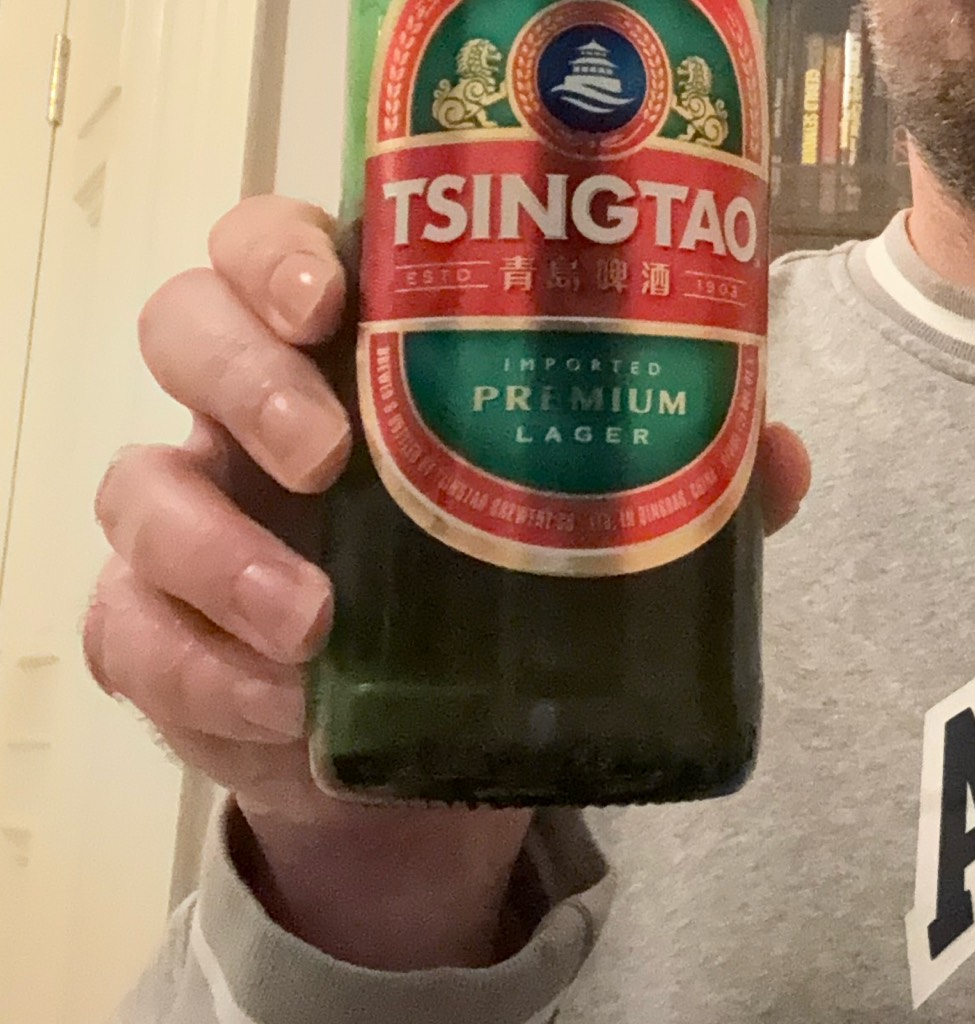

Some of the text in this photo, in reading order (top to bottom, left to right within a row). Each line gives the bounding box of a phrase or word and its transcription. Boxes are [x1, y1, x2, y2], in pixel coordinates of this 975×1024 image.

[382, 172, 758, 263] TSINGTAO
[503, 357, 661, 377] IMPORTED
[472, 384, 687, 416] PREMIUM
[515, 425, 650, 445] LAGER
